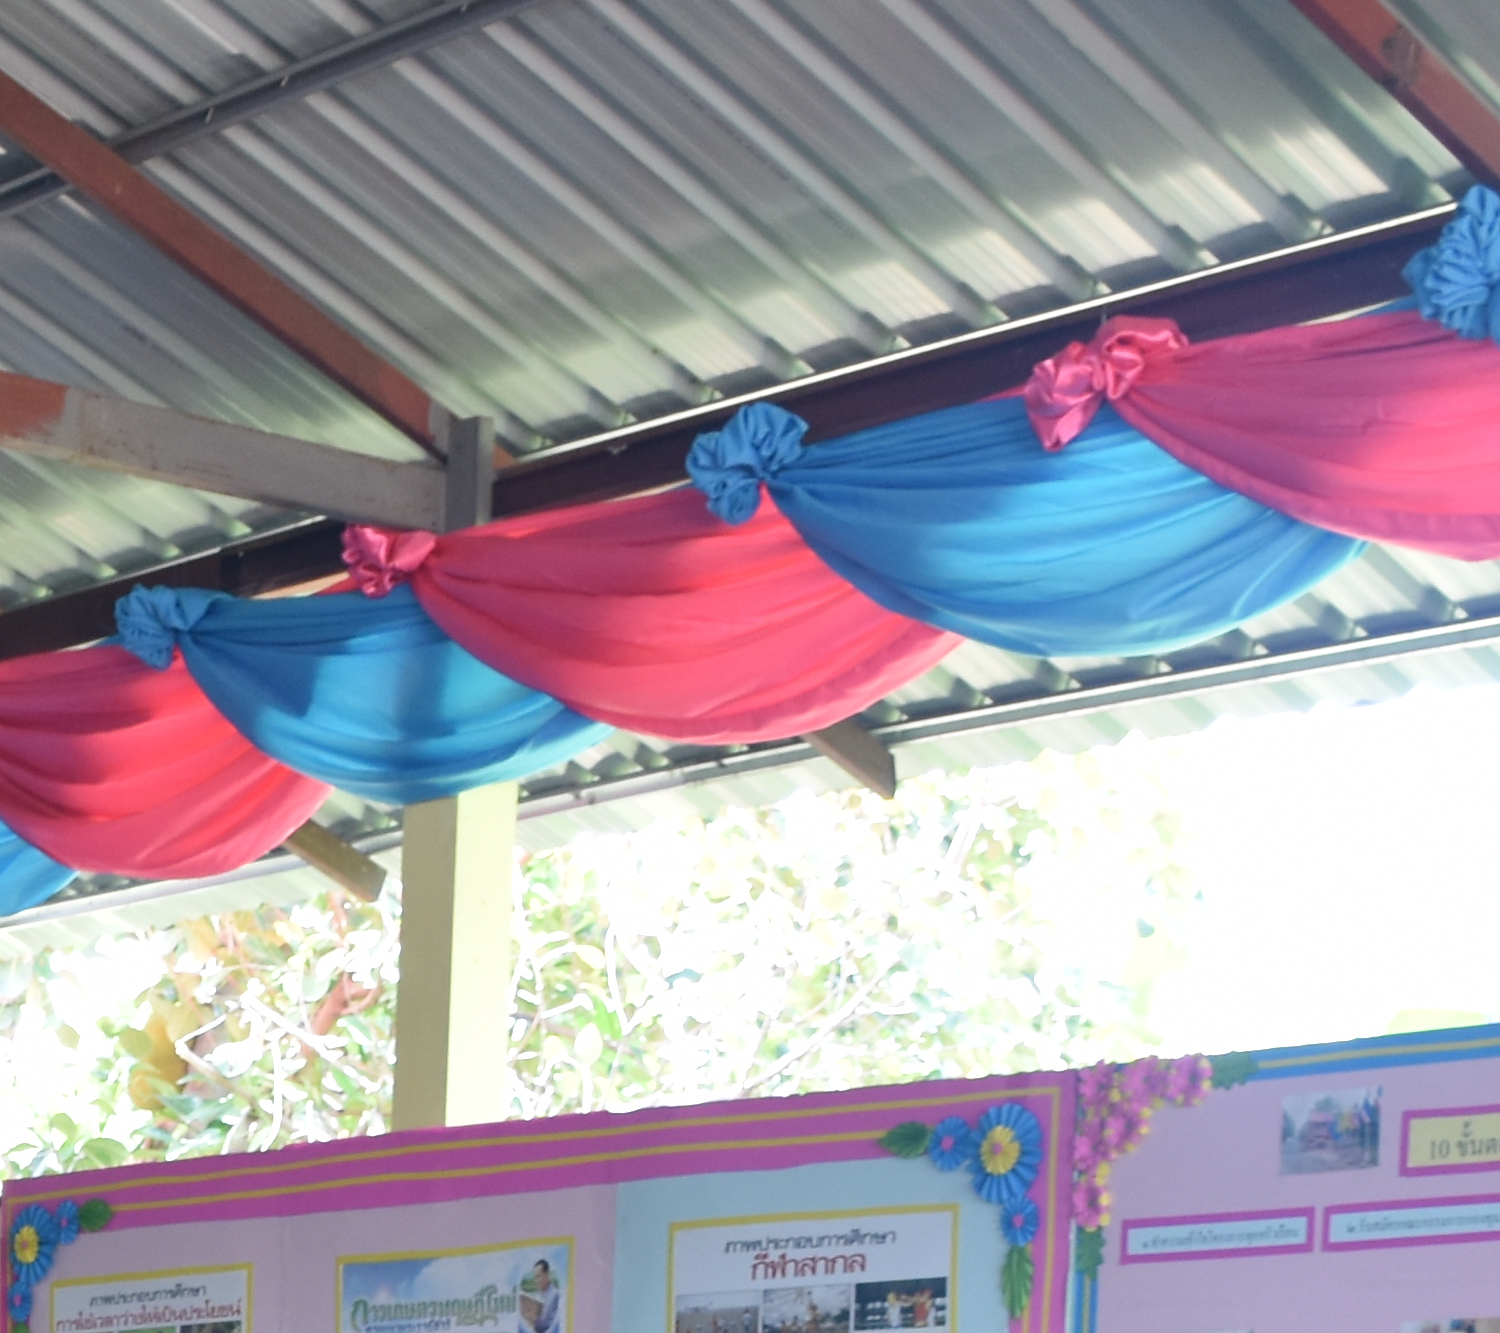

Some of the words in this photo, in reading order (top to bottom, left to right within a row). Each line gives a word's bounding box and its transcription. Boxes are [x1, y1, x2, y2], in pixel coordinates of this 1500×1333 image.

[1429, 1138, 1451, 1161] 10
[750, 1252, 867, 1281] กีฬาสากล
